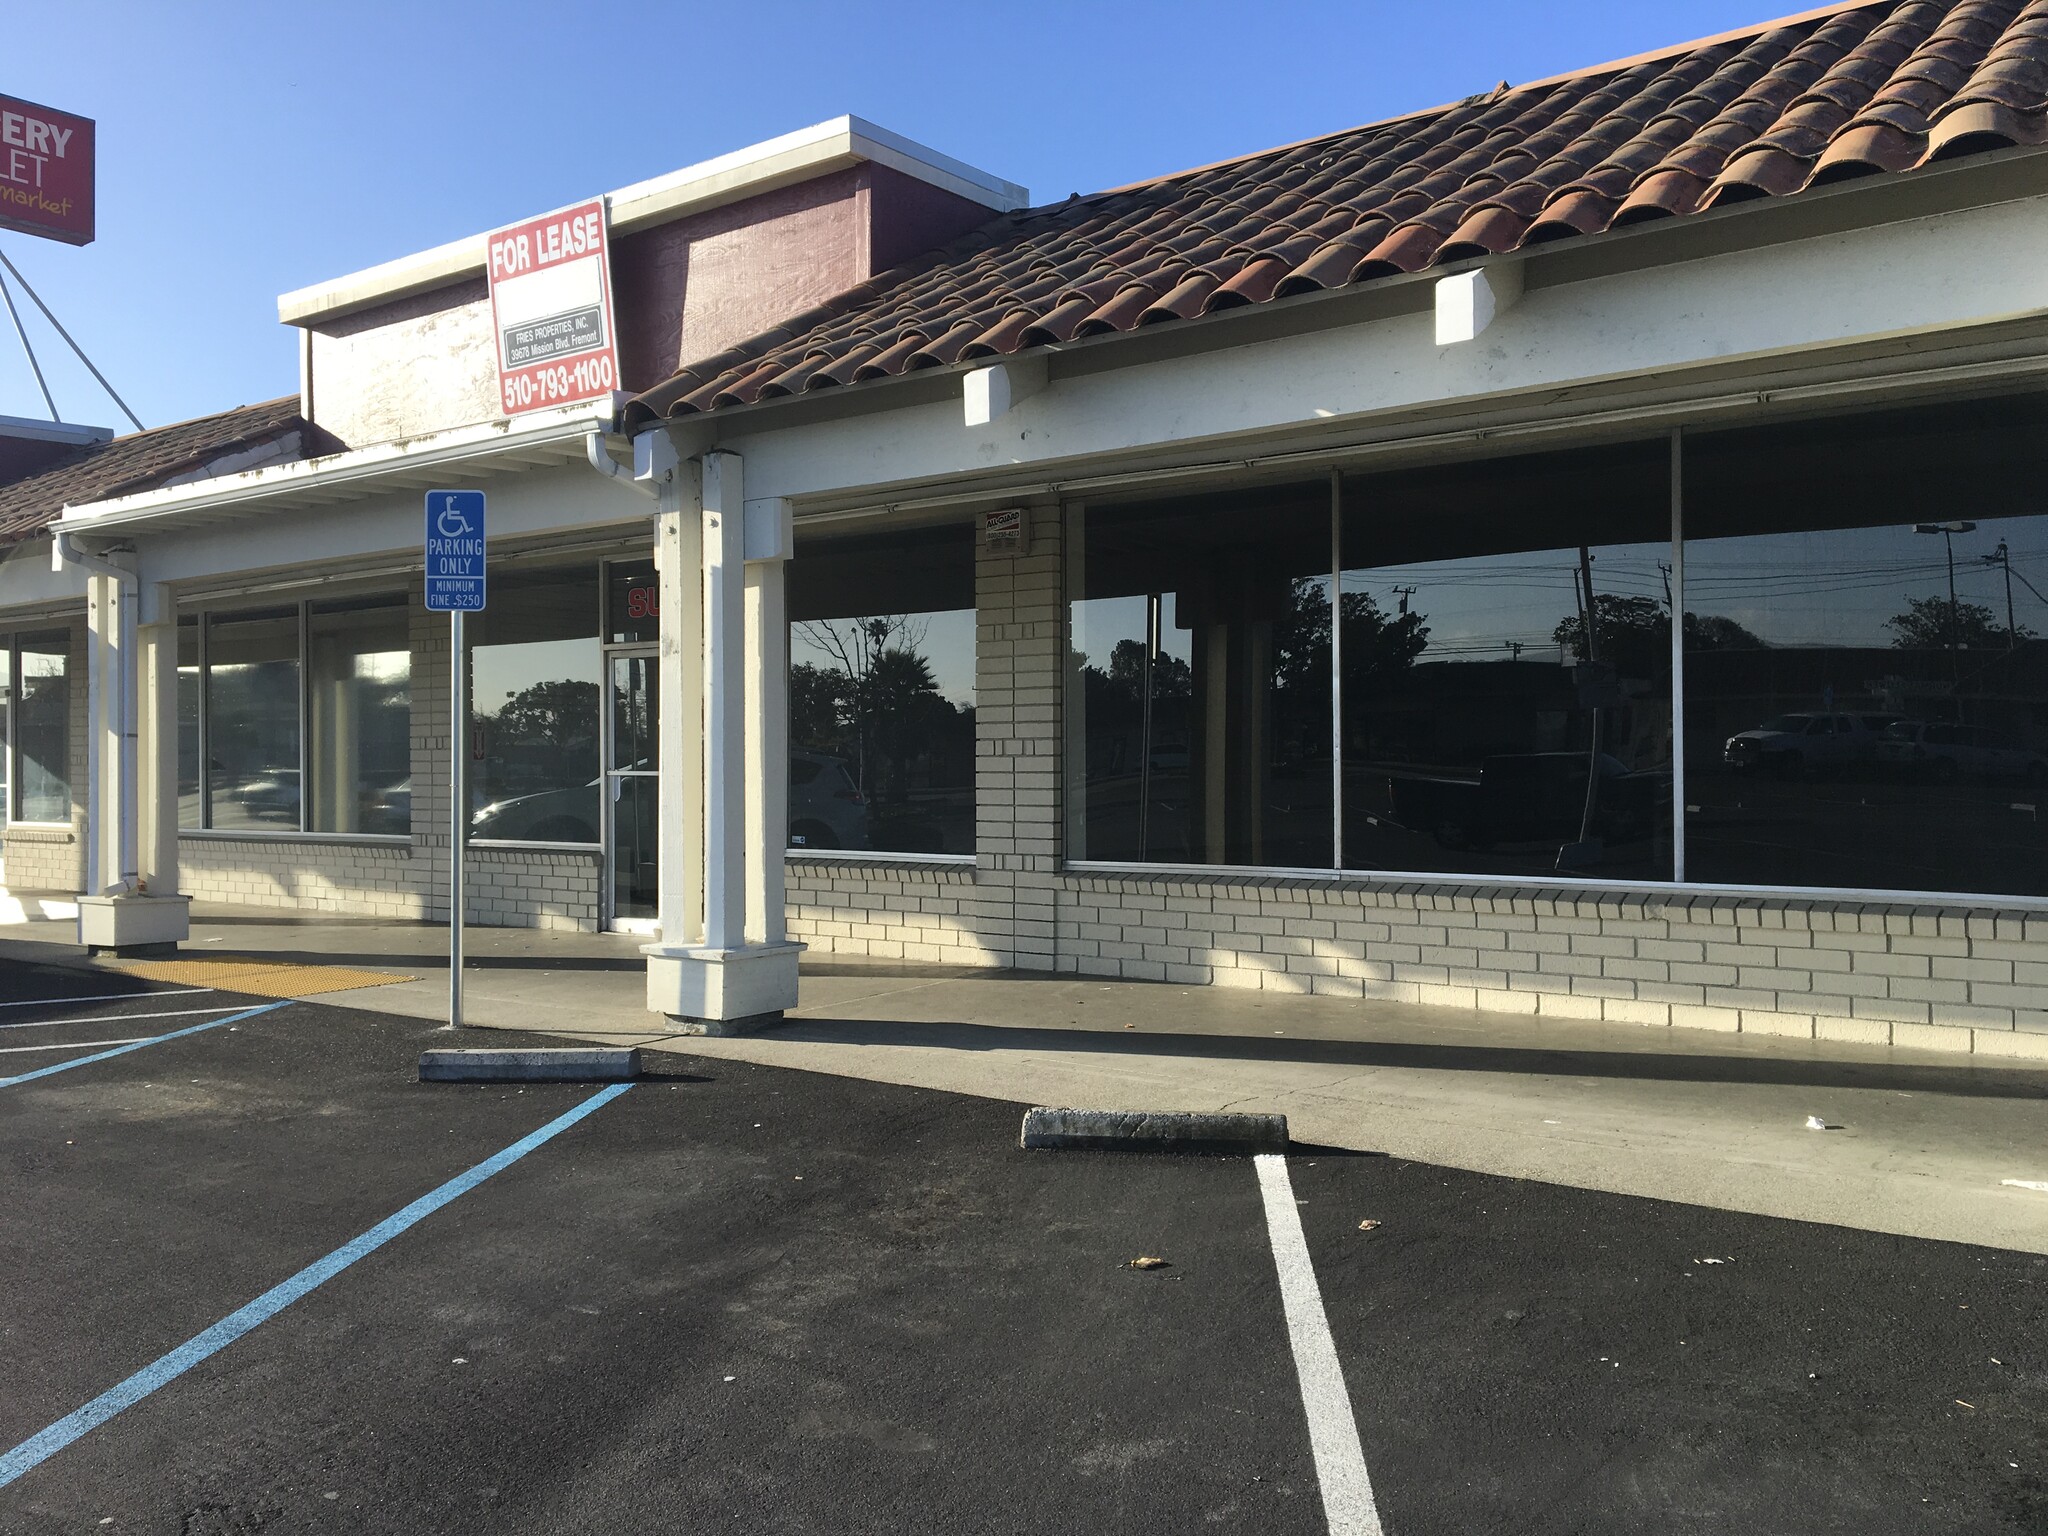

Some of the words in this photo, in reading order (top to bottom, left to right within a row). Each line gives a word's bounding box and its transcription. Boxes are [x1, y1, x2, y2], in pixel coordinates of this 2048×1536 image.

[0, 110, 73, 158] ERY
[491, 234, 530, 277] FOR
[536, 212, 600, 265] LEASE
[516, 330, 534, 344] FRIES
[535, 320, 574, 340] PROPERTIES,
[575, 317, 589, 329] INC.
[511, 346, 530, 361] 39678
[531, 341, 554, 356] Mission
[555, 336, 570, 350] Blvd.
[571, 330, 597, 346] Fremont
[504, 355, 612, 408] 510-793-1100
[429, 539, 482, 555] PARKING
[440, 558, 472, 574] ONLY
[431, 594, 449, 606] FINE
[455, 594, 480, 606] $250
[436, 581, 475, 592] MINIMUM
